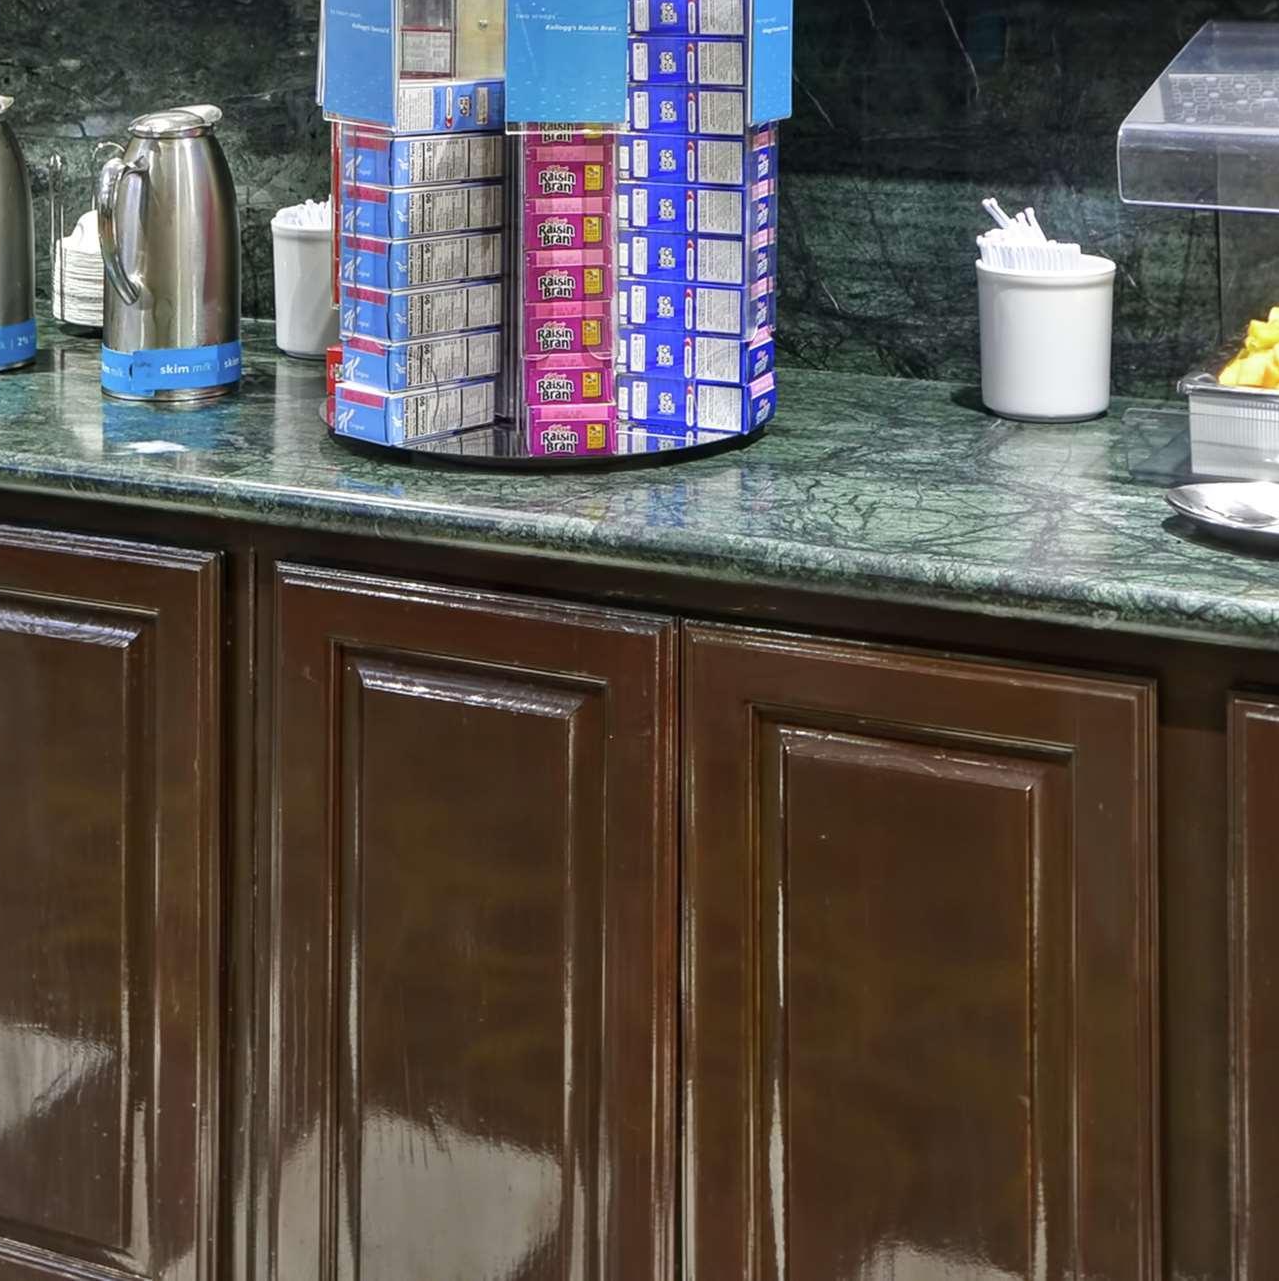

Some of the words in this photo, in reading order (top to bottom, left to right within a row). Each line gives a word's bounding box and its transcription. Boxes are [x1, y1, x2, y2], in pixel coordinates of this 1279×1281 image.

[539, 172, 575, 184] Raisin
[544, 183, 571, 193] Bran
[538, 224, 574, 235] Raisin
[543, 234, 570, 245] Bran
[539, 276, 575, 288] Raisin
[543, 286, 571, 297] Bran
[537, 328, 573, 339] Raisin
[542, 338, 569, 349] Bran
[160, 364, 189, 374] skim
[538, 380, 573, 391] Raisin
[542, 390, 569, 401] Bran
[542, 432, 577, 443] Raisin
[546, 442, 574, 453] Bran
